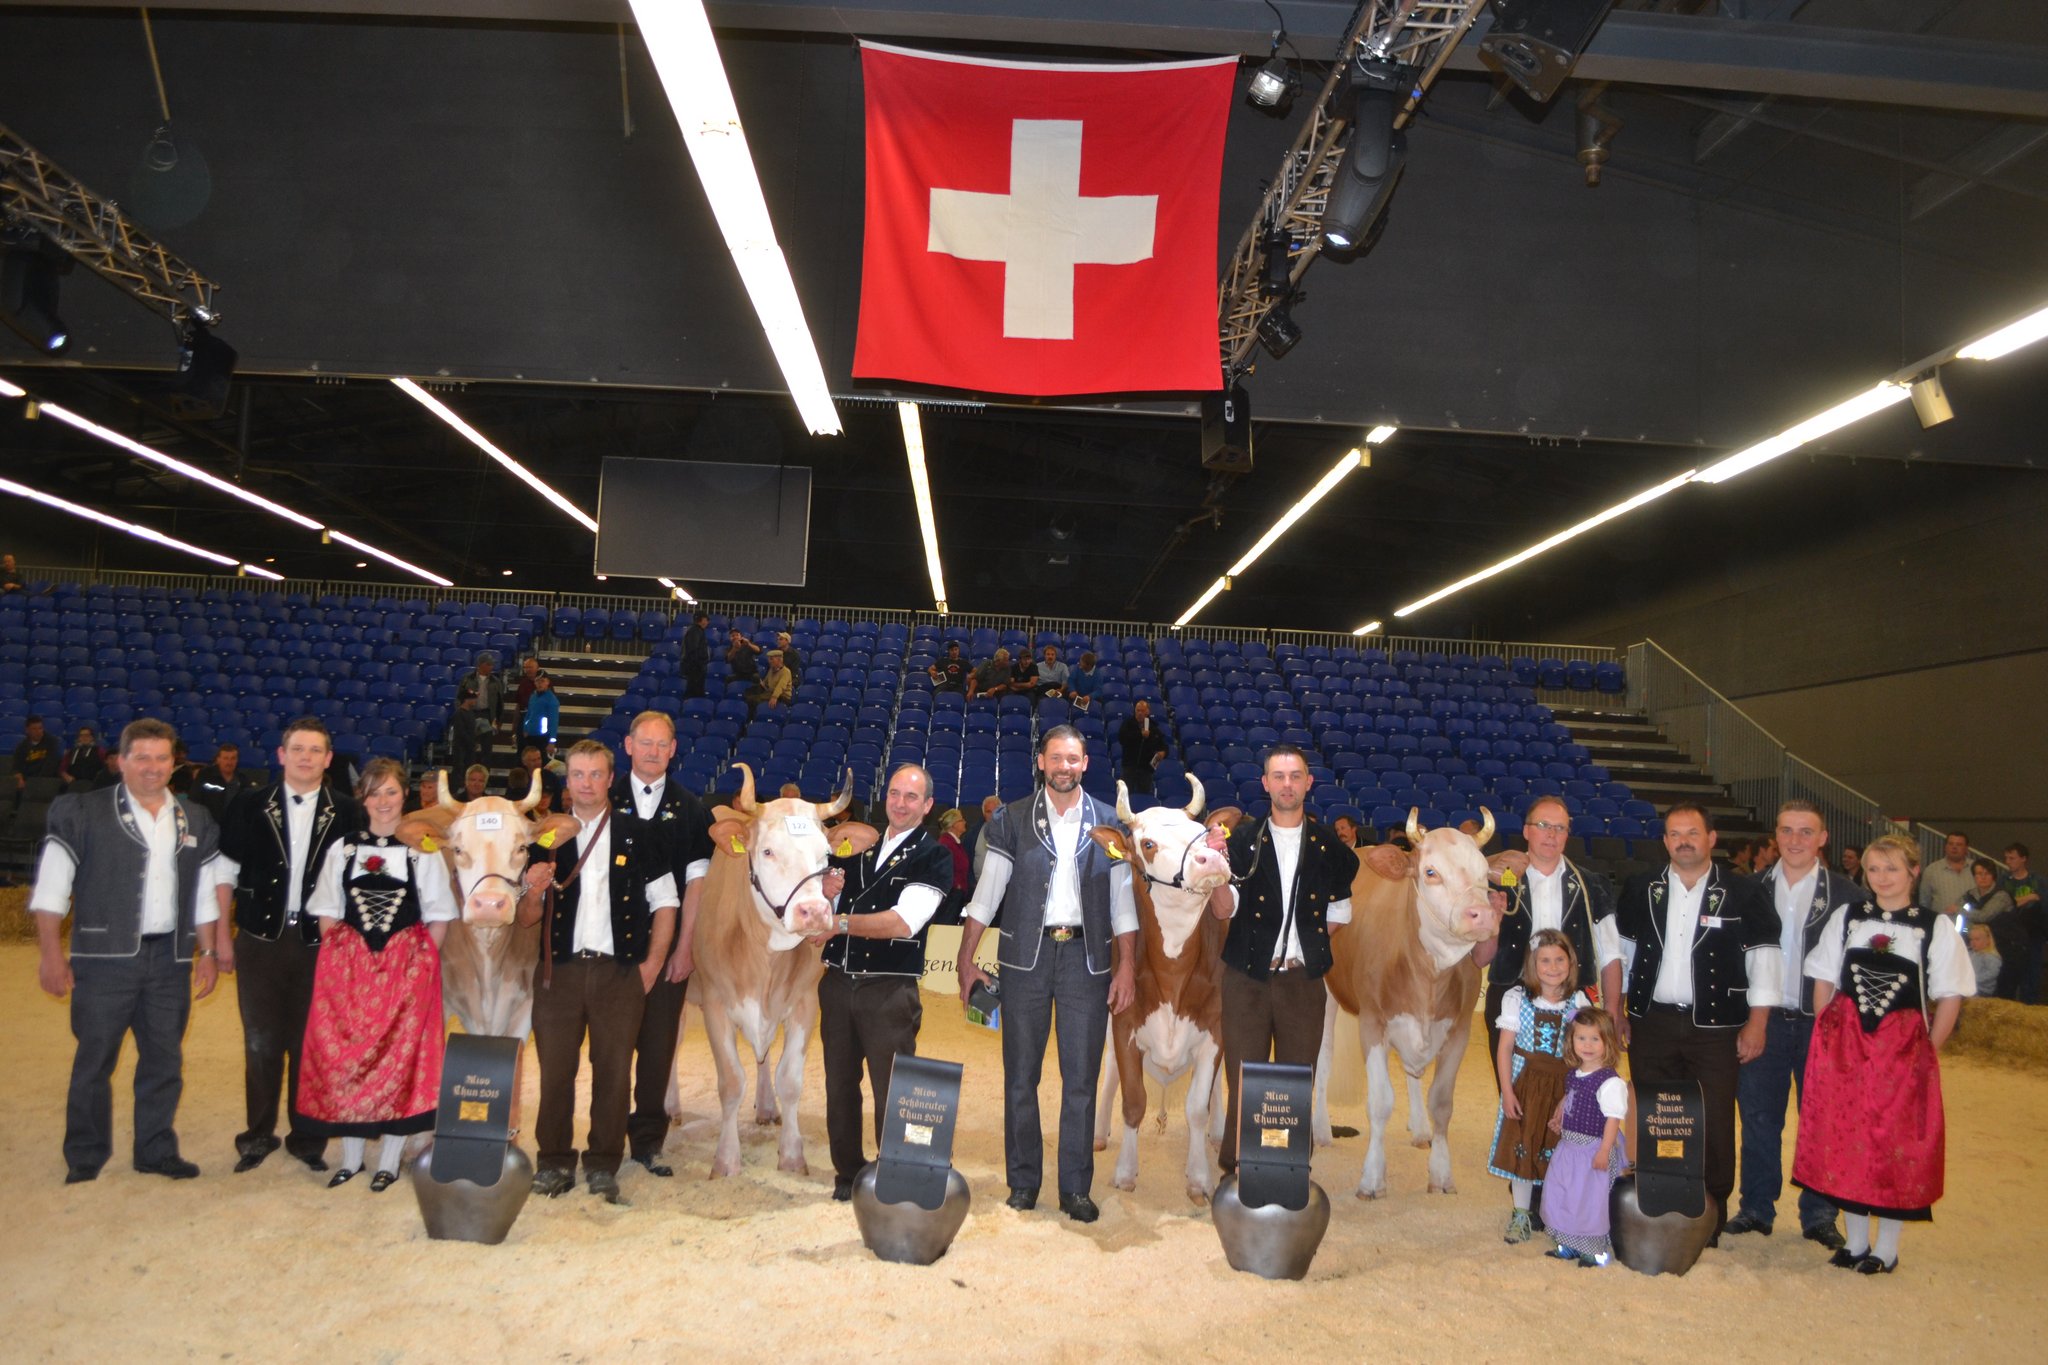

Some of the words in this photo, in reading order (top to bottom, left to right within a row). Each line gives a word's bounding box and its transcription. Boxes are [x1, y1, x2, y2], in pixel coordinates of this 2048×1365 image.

[481, 817, 498, 825] 140
[479, 1088, 500, 1098] 2015
[1261, 1102, 1291, 1114] Junior
[1655, 1102, 1684, 1114] Junior
[924, 1113, 943, 1124] 2015
[1279, 1116, 1299, 1126] 2015
[1673, 1127, 1692, 1137] 2015
